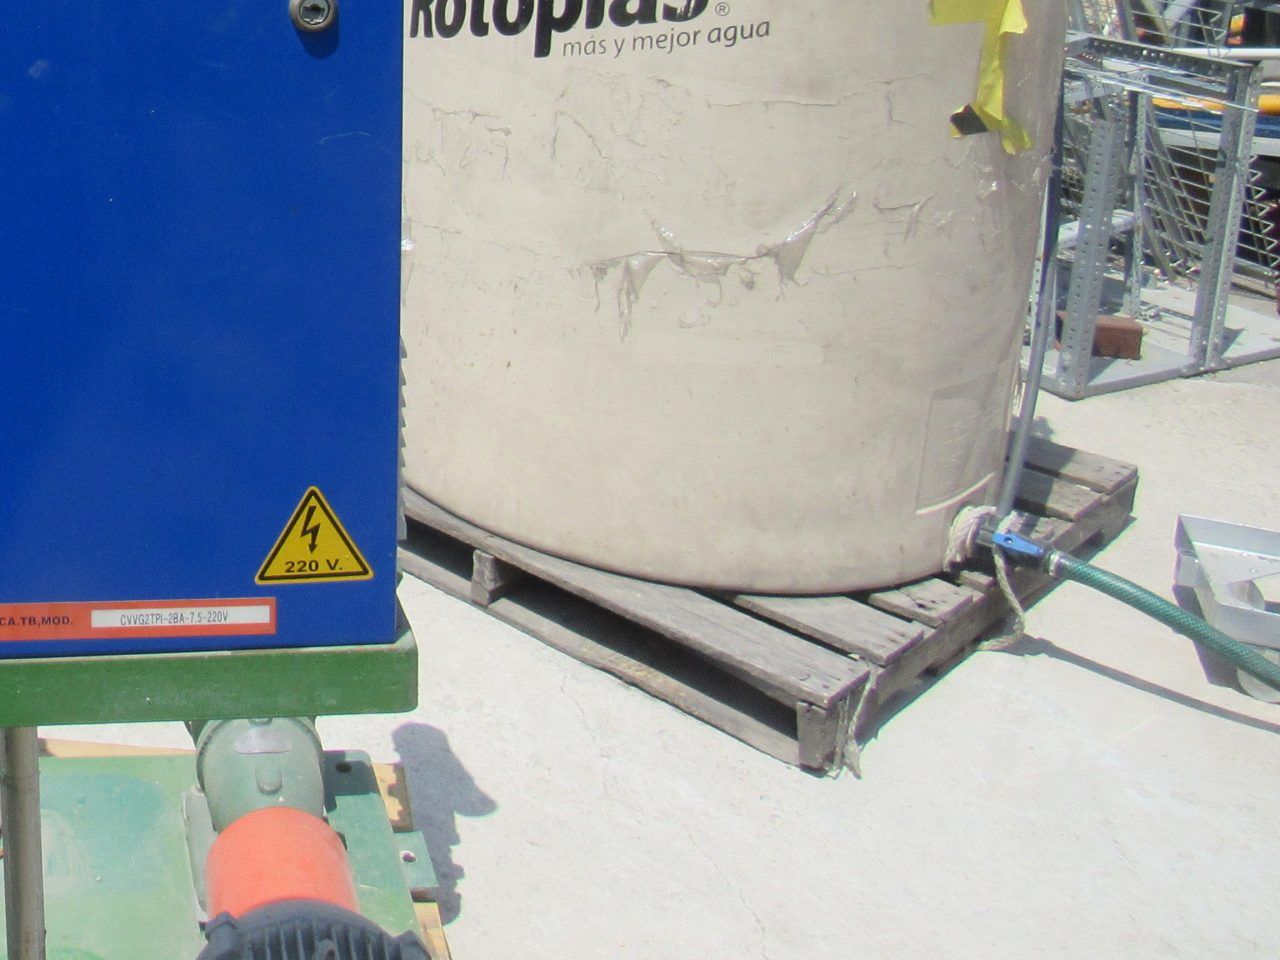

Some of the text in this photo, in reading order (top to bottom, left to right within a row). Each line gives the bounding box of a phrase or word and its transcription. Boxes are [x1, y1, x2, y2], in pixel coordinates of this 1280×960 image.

[562, 19, 771, 60] más y mejor agua
[284, 558, 344, 574] 220 V.
